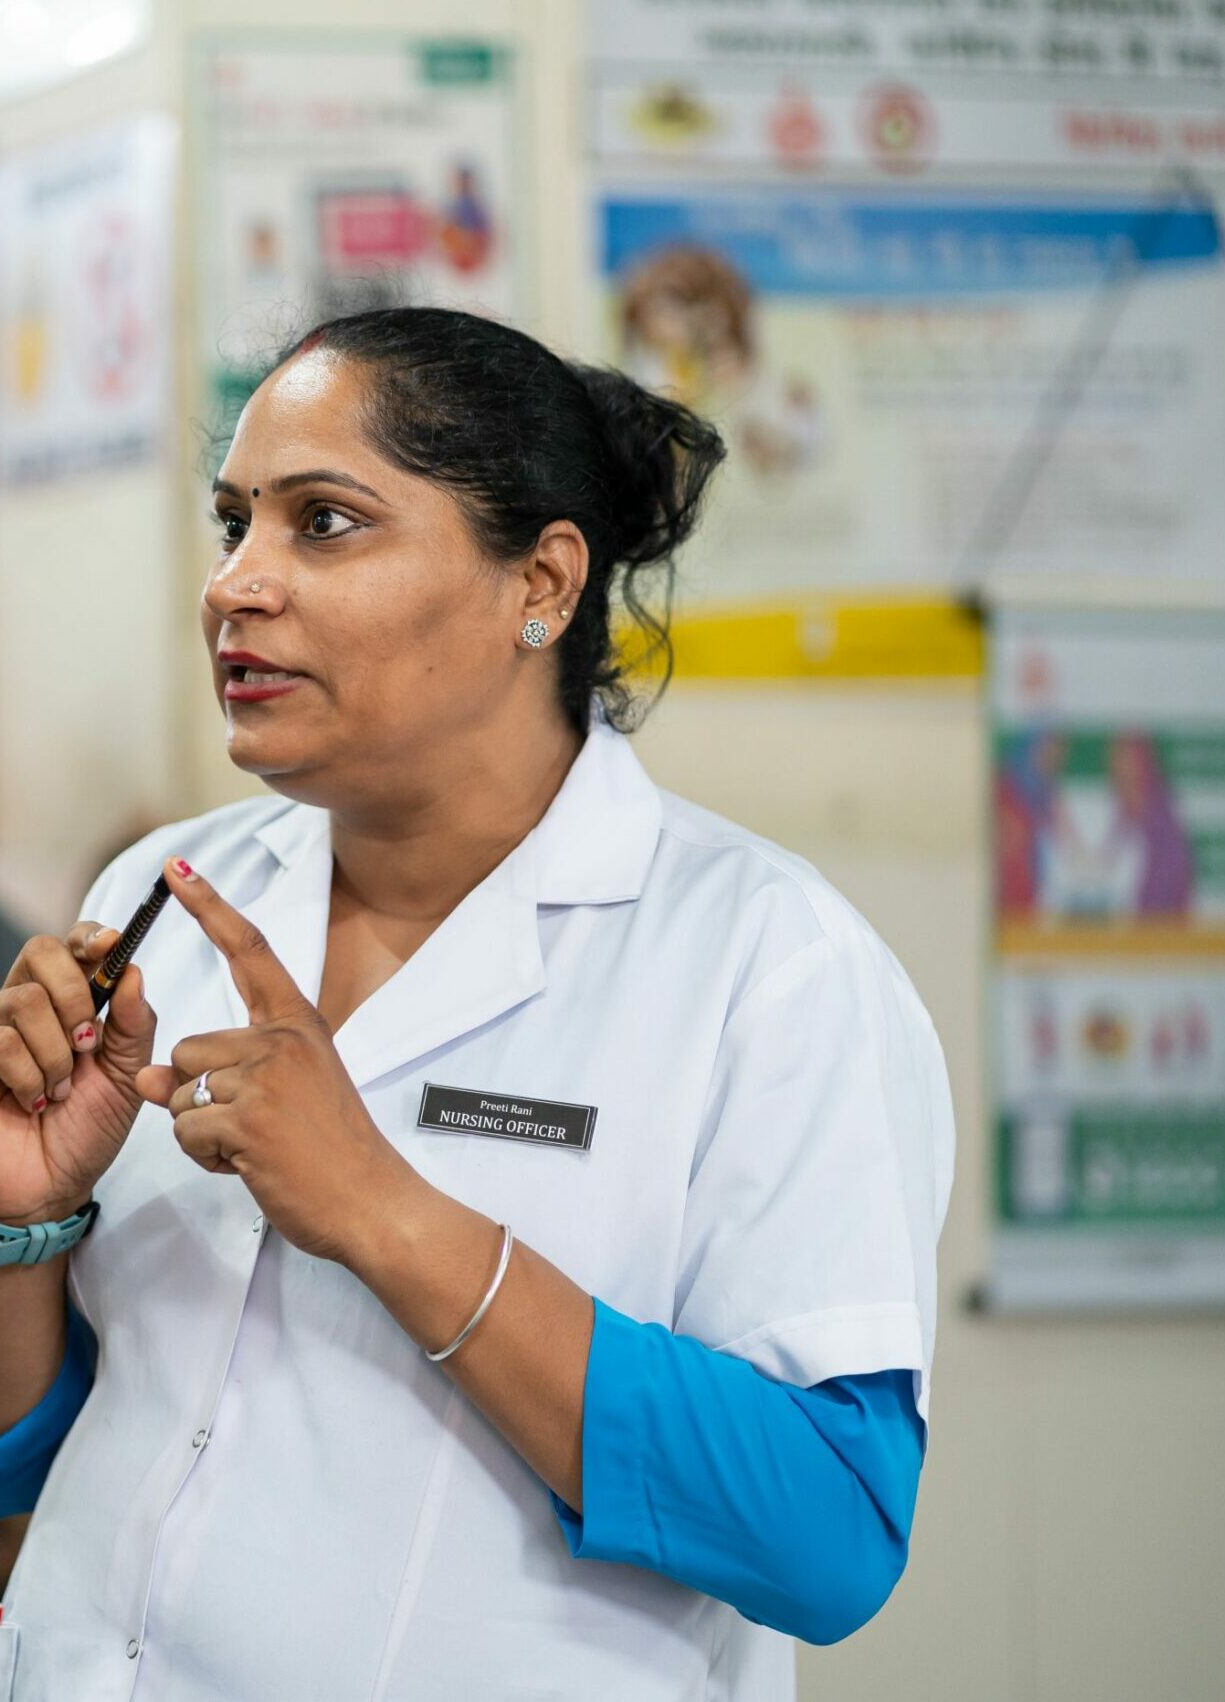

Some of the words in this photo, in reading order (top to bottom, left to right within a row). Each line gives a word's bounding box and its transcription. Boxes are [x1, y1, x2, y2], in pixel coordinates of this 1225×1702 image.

[480, 1100, 509, 1113] Preeti
[511, 1105, 533, 1116] Rani
[440, 1110, 503, 1130] NURSING
[506, 1120, 566, 1140] OFFICER
